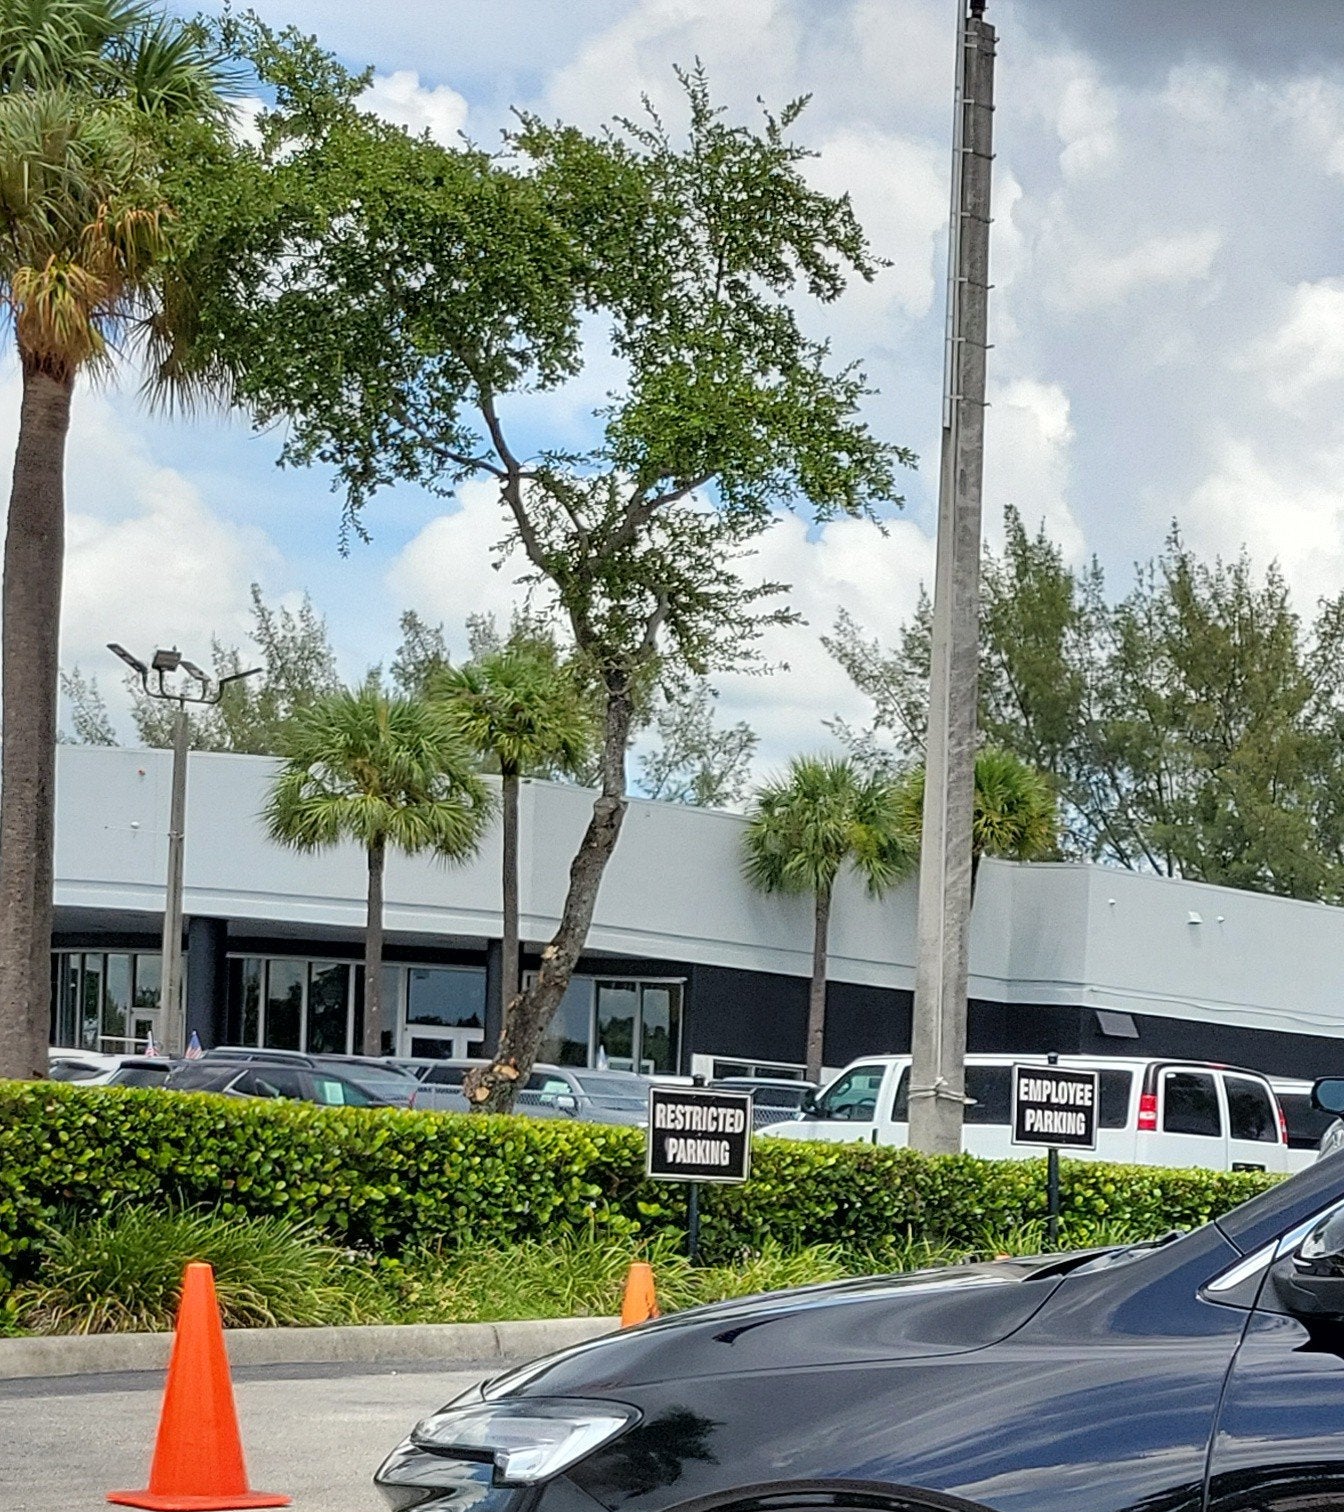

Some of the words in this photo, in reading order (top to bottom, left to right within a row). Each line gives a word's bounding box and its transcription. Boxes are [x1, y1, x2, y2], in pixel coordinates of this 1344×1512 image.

[1018, 1077, 1093, 1107] EMPLOYEE
[654, 1102, 745, 1134] RESTRICTED
[1024, 1108, 1086, 1136] PARKING
[666, 1137, 730, 1167] PARKING
